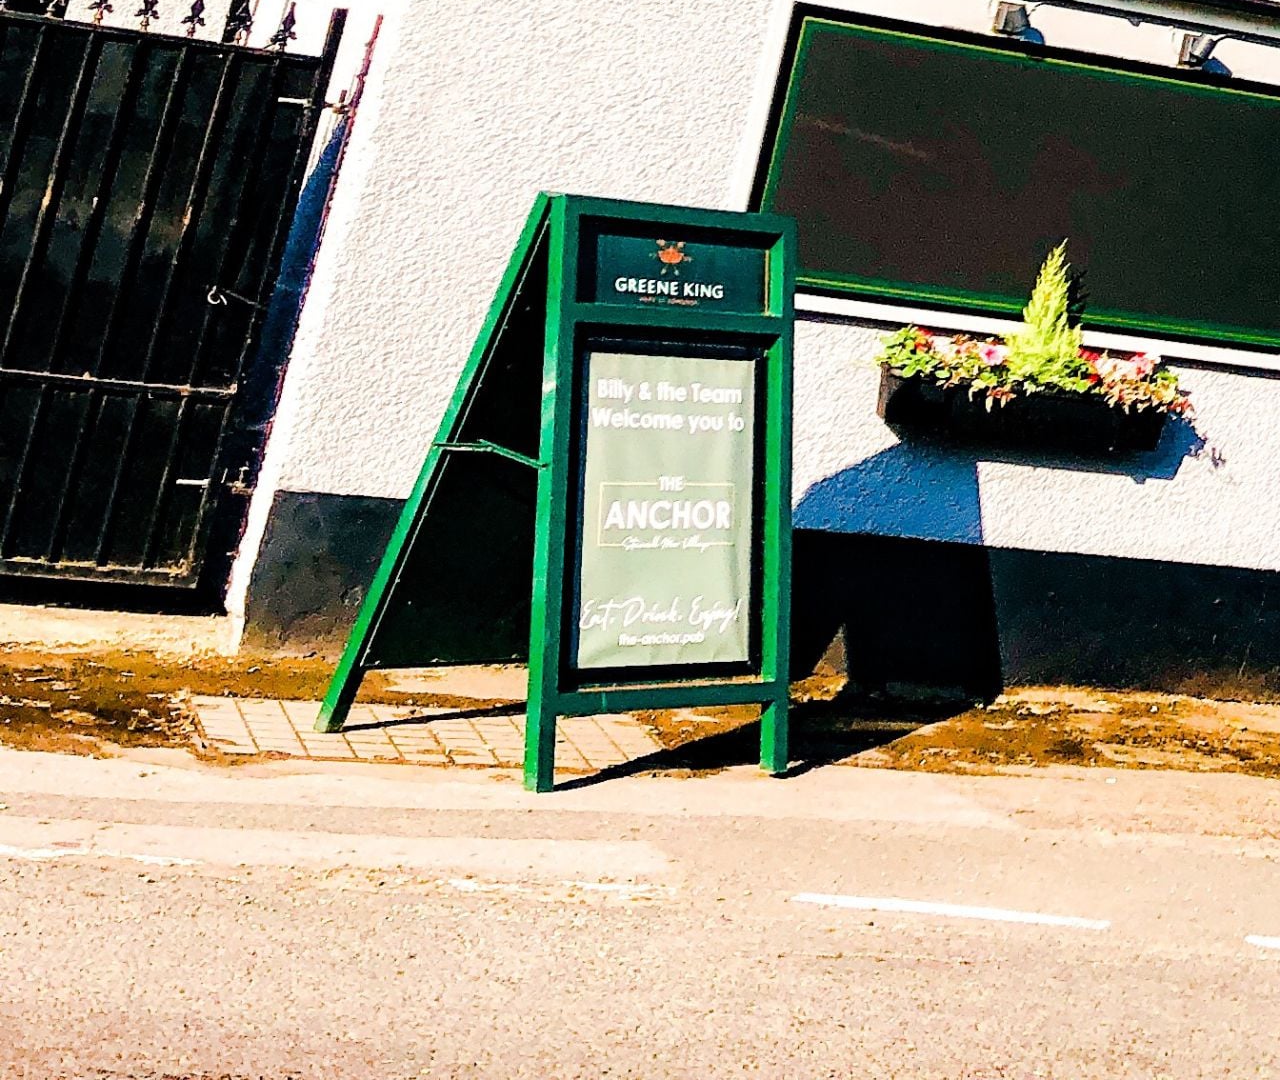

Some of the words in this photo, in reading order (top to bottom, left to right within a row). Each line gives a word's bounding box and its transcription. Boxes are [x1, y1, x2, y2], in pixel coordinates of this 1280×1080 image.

[615, 277, 679, 296] GREENE
[683, 282, 724, 299] KING
[597, 379, 634, 404] Billy
[638, 381, 652, 400] &
[657, 381, 689, 402] the
[689, 383, 742, 404] Team
[591, 407, 683, 430] Welcome
[688, 415, 724, 434] you
[727, 412, 744, 431] to
[658, 475, 685, 491] THE
[604, 499, 731, 530] ANCHOR
[579, 599, 617, 631] Eat.
[620, 596, 683, 627] Drink.
[688, 595, 742, 634] Enjoy!
